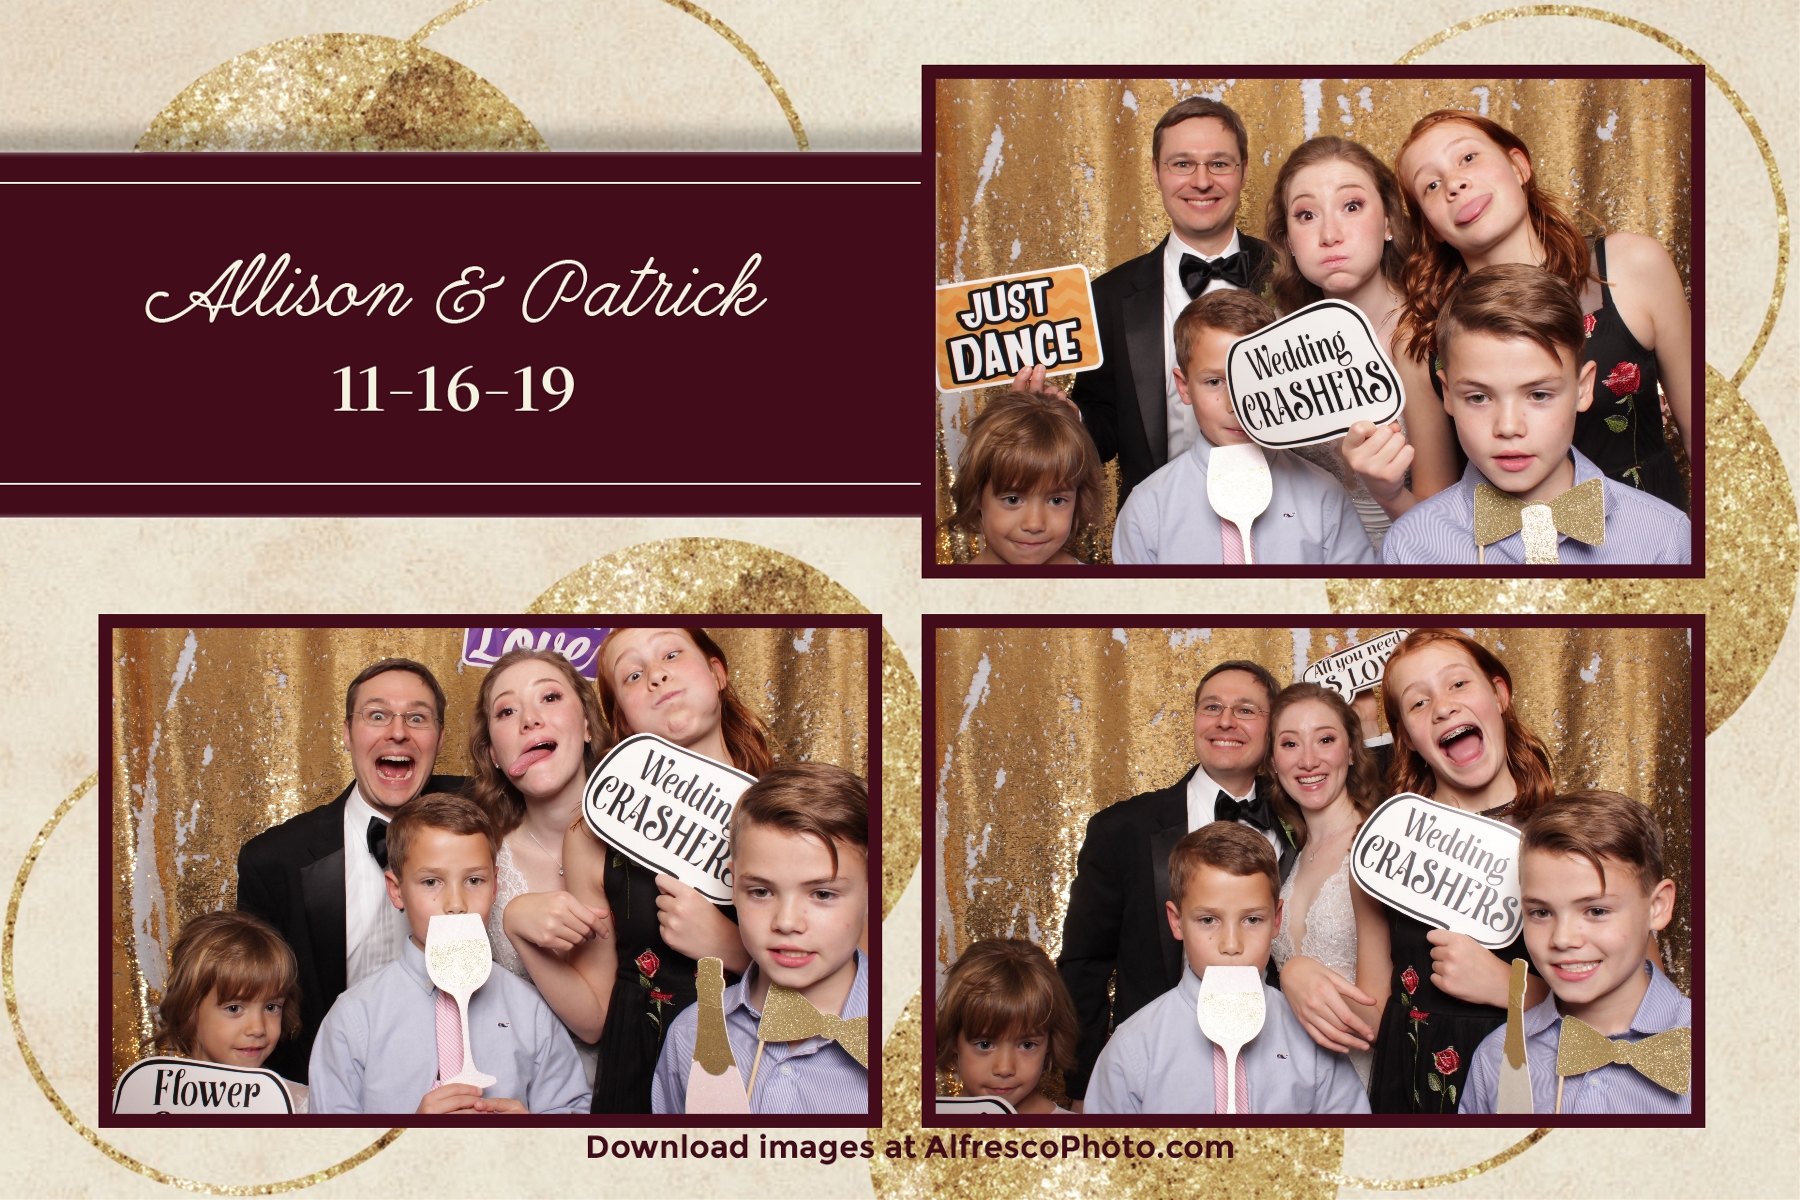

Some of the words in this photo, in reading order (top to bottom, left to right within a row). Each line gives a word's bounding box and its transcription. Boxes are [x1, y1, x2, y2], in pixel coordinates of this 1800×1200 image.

[958, 278, 1052, 330] JUST
[948, 319, 1080, 382] DANCE
[1244, 330, 1353, 381] Wedding
[1242, 360, 1393, 431] CRASHERS
[468, 628, 601, 672] Love
[1313, 656, 1332, 679] All
[1335, 650, 1363, 673] you
[1366, 630, 1402, 656] need
[1347, 650, 1393, 688] LO
[1404, 806, 1510, 886] Wedding
[1360, 834, 1519, 933] CRASHERS
[152, 1068, 261, 1108] Flower
